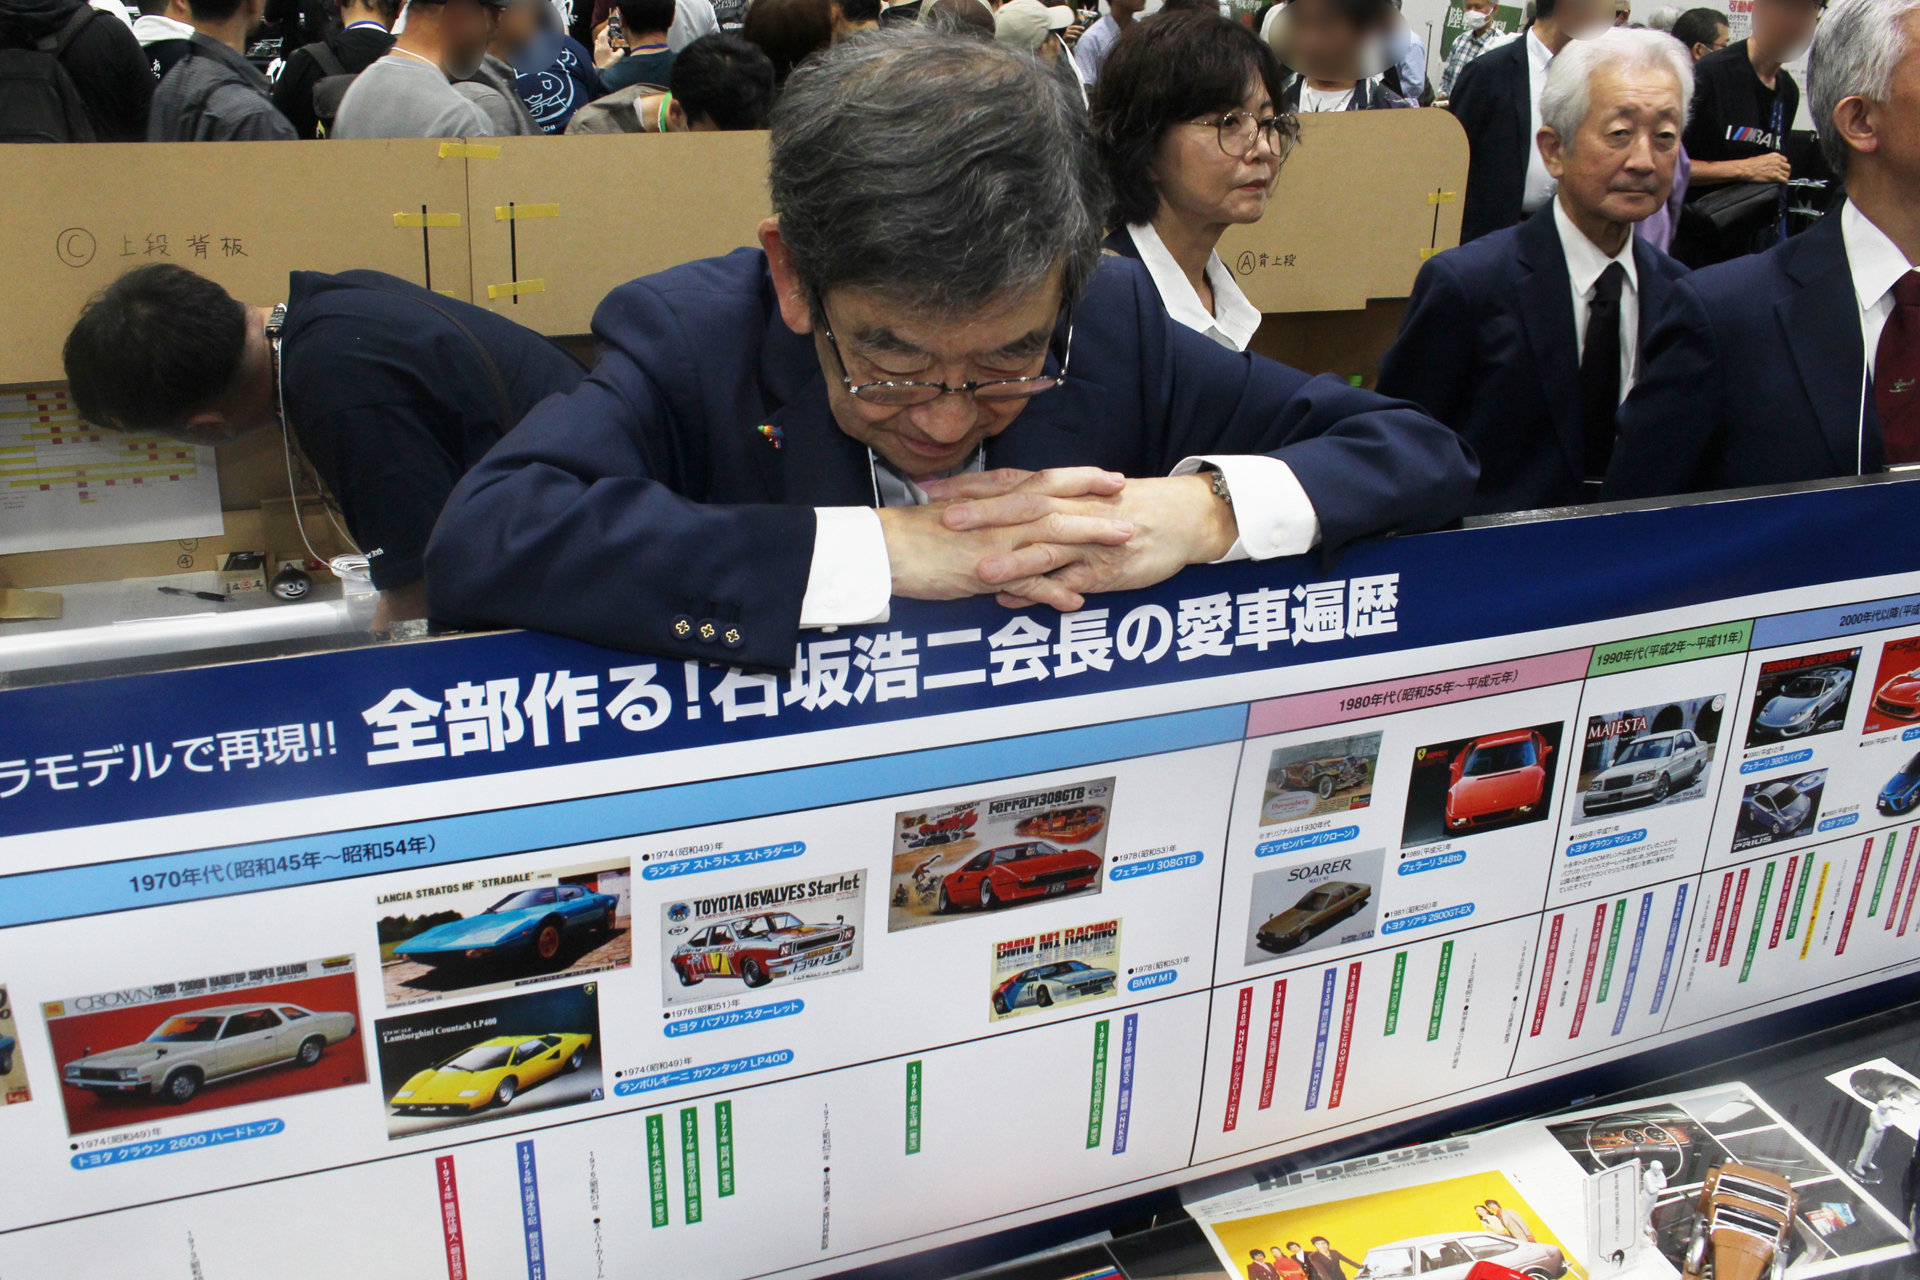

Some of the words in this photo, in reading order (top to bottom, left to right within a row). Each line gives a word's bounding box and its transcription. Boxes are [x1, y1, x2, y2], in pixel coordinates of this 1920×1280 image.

[1587, 716, 1648, 740] MAJESTA
[1733, 835, 1772, 850] PRIUS
[649, 861, 692, 878] ランチア
[694, 854, 741, 871] ストラトス
[1114, 862, 1155, 878] フェラーリ
[1287, 858, 1352, 882] SOARER
[377, 891, 413, 905] LANCIA
[416, 884, 460, 899] STRATOS
[462, 881, 475, 891] HF
[808, 873, 860, 897] Starlet
[1065, 920, 1118, 945] RACING
[1132, 974, 1157, 989] BMW
[1158, 971, 1173, 985] M1
[384, 1027, 434, 1044] Lamborghini
[435, 1021, 472, 1035] Countach
[473, 1016, 498, 1029] LP400
[670, 1020, 697, 1034] トヨタ
[750, 1051, 788, 1068] LP400
[78, 1152, 113, 1167] トヨタ
[117, 1143, 165, 1160] クラウン
[169, 1135, 207, 1151] 2600
